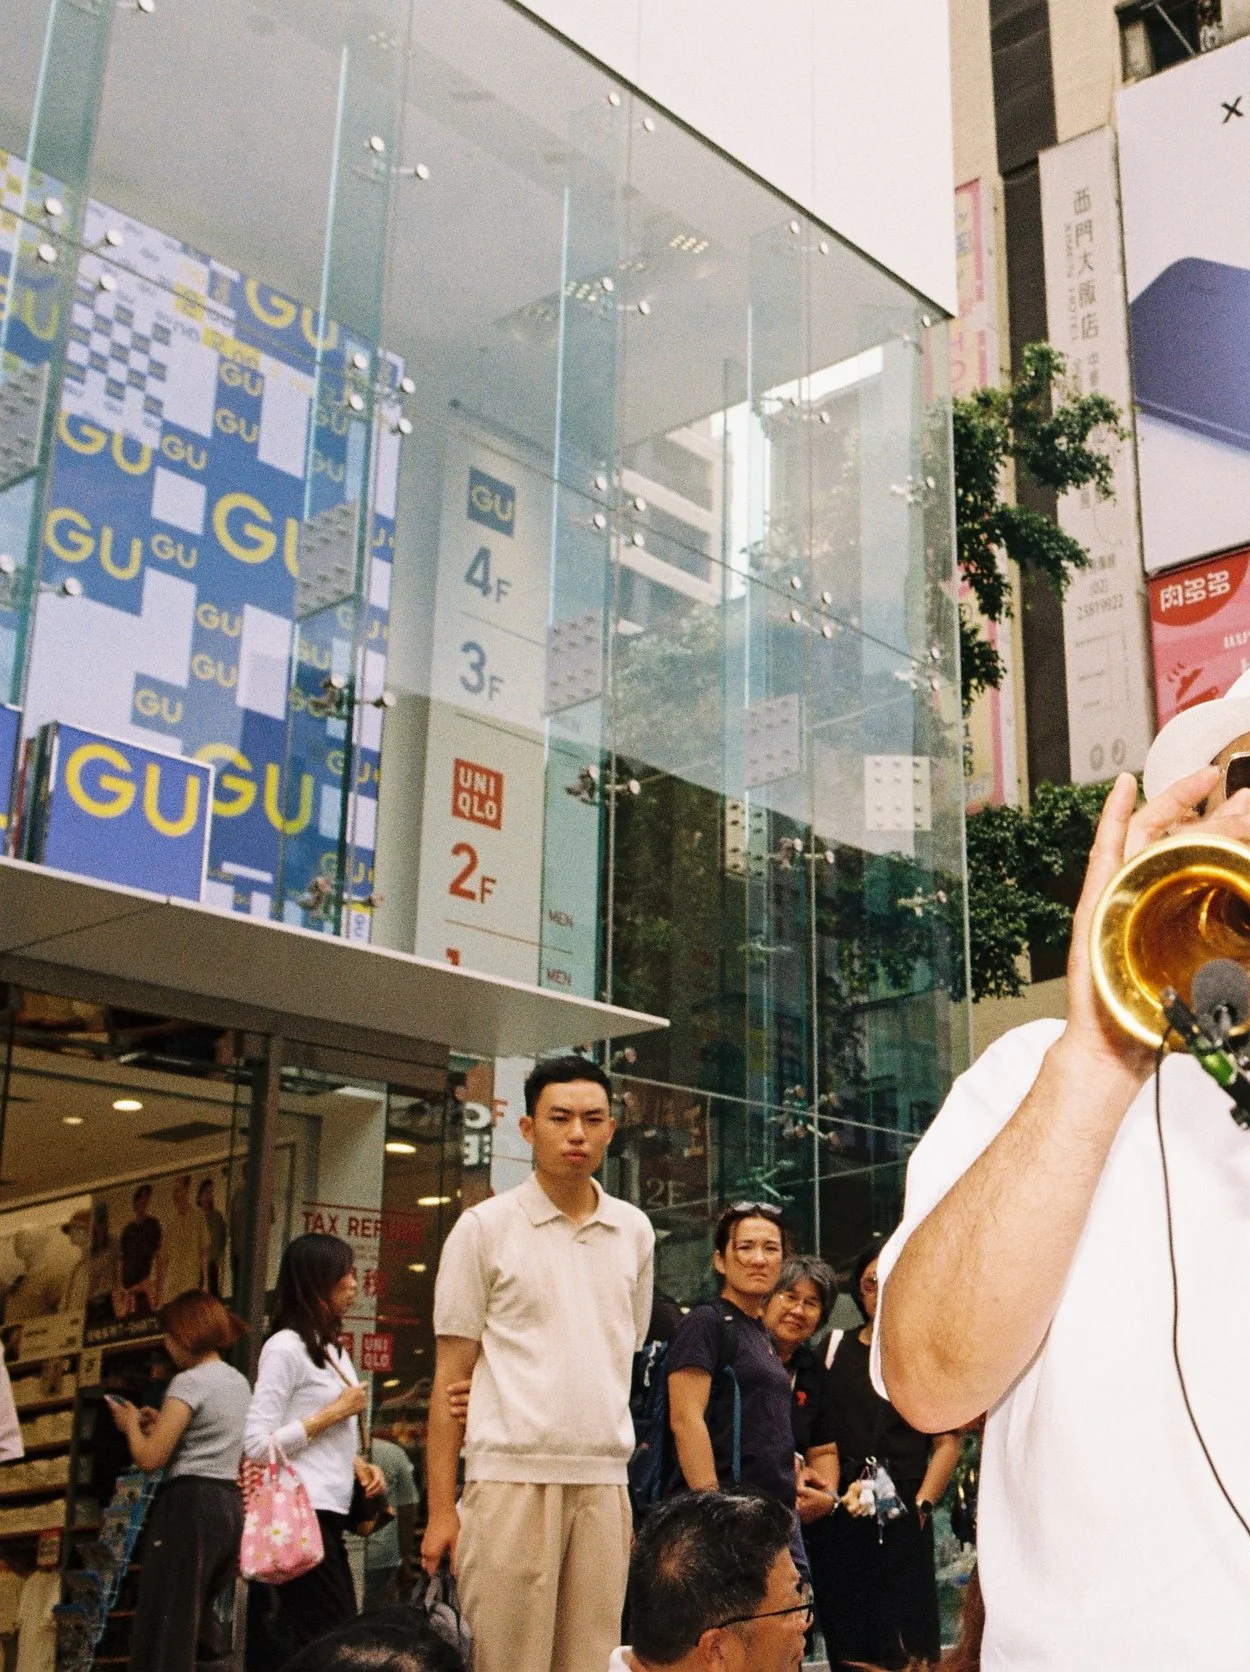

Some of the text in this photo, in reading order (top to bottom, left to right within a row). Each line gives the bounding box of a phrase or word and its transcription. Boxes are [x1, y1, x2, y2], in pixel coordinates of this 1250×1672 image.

[219, 359, 264, 397] GU
[59, 410, 153, 477] GU
[215, 406, 260, 444] GU
[161, 433, 208, 471] GU
[471, 484, 515, 523] GU
[44, 507, 142, 582] GU
[150, 534, 199, 571] GU
[464, 545, 511, 603] 4F
[1160, 569, 1231, 613] 肉多多
[197, 603, 242, 638] GU
[191, 653, 238, 689] GU
[460, 640, 505, 700] 3F
[134, 688, 183, 725] GU
[65, 743, 201, 838] GU
[196, 742, 314, 836] GU
[458, 764, 496, 799] UNI
[456, 792, 497, 822] QLO
[448, 842, 497, 904] 2F
[303, 1212, 340, 1235] TAX
